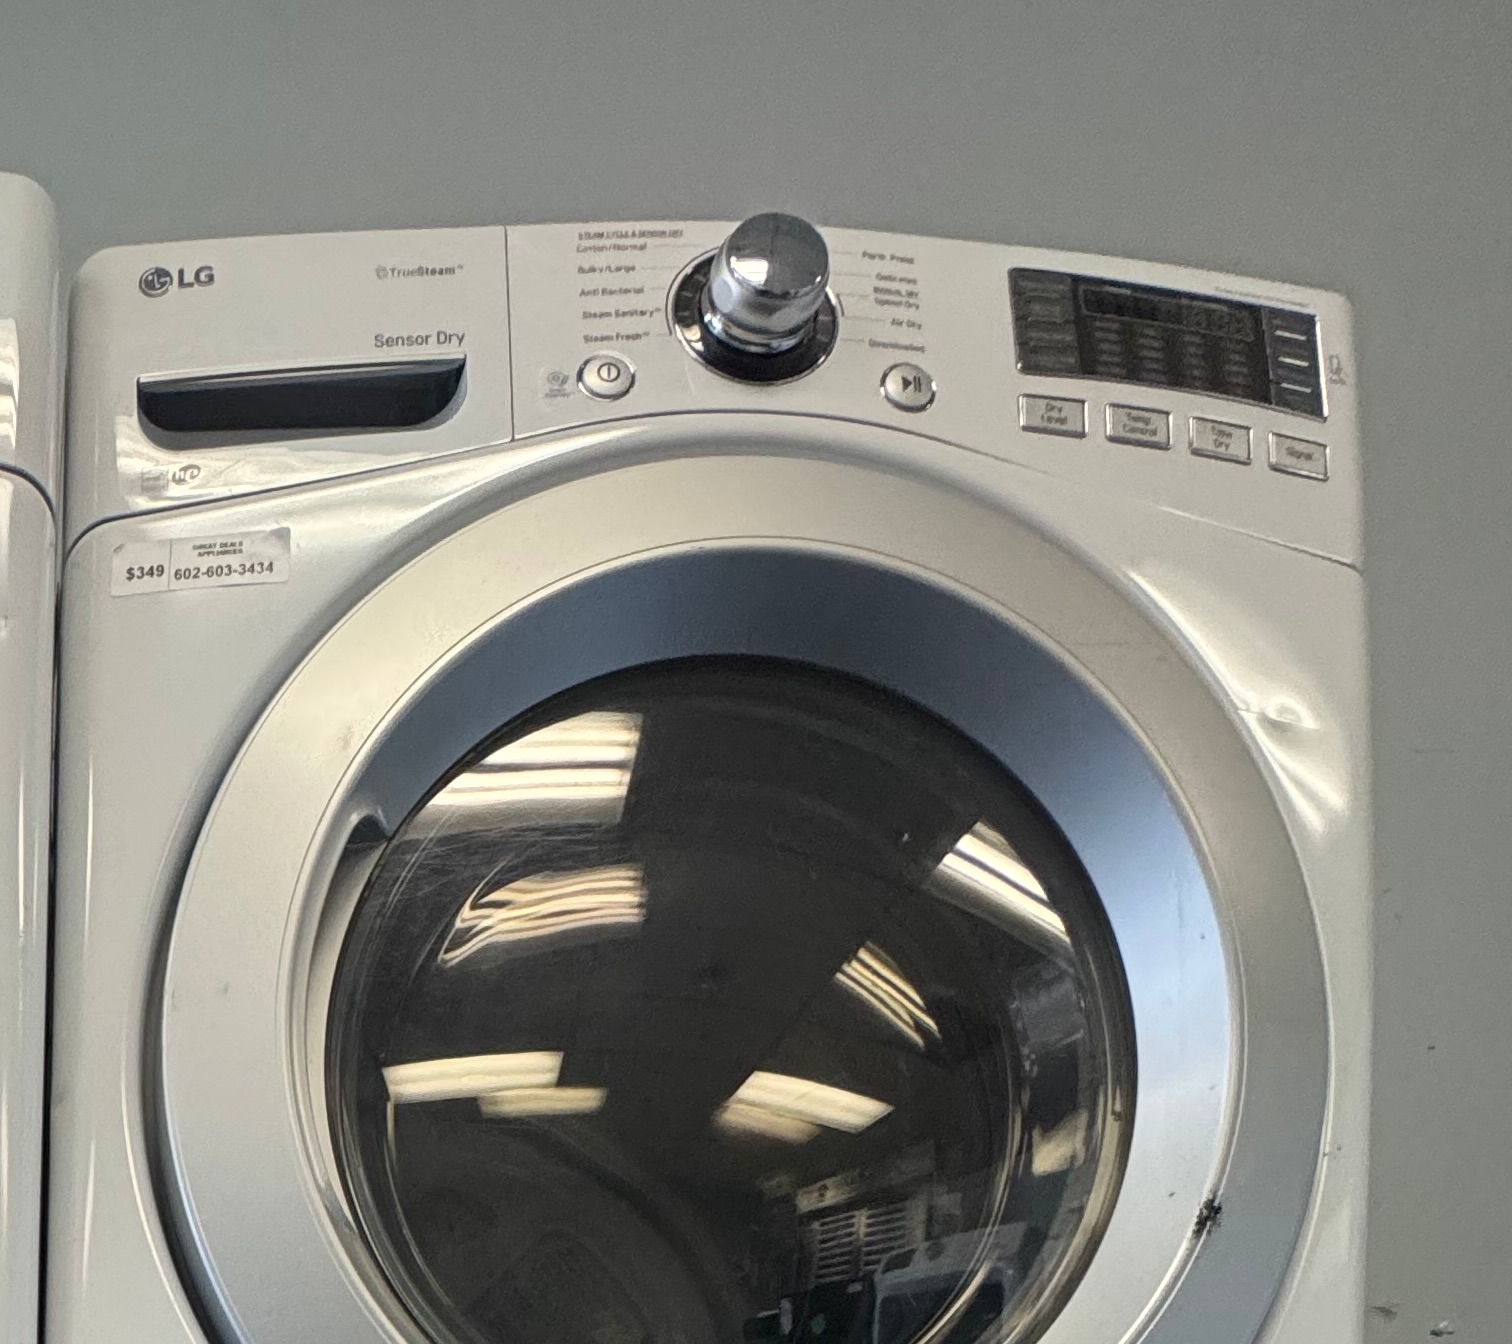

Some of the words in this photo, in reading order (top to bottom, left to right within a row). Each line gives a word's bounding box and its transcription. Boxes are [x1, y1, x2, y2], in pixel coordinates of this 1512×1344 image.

[178, 265, 216, 289] LG
[373, 332, 434, 349] Sensor
[437, 330, 466, 347] Dry
[126, 564, 165, 582] $349
[174, 560, 274, 580] 602-603-3434
